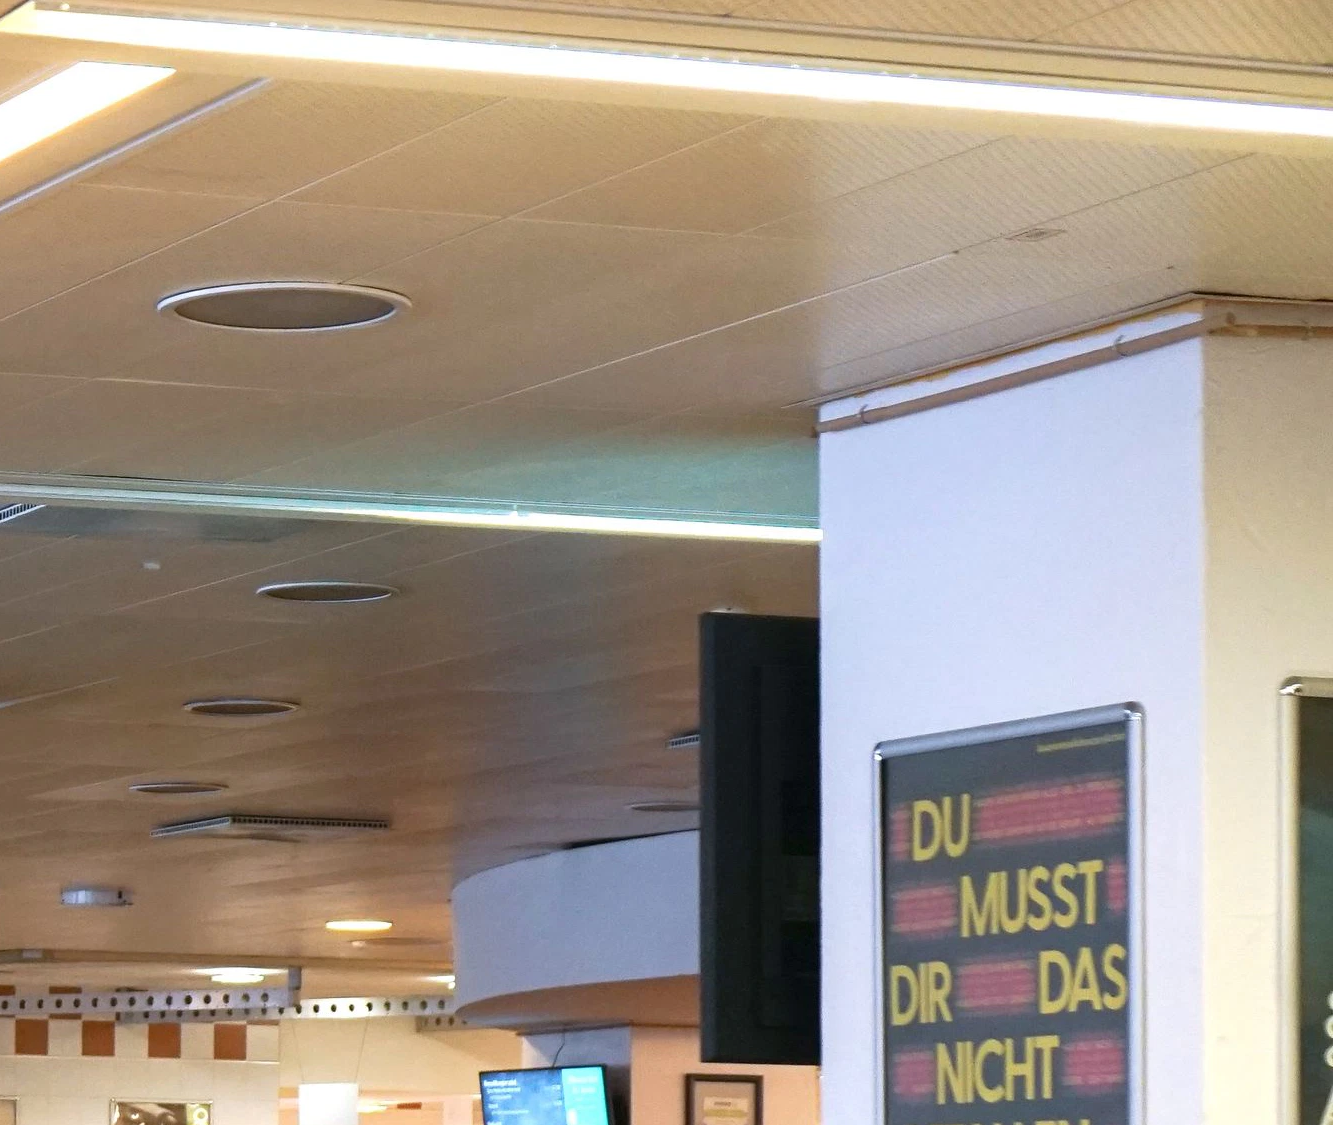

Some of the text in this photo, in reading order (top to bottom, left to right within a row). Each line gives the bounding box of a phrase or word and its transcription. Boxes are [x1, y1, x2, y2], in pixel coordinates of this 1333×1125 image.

[911, 793, 972, 861] DU
[959, 860, 1104, 938] MUSST
[890, 943, 1127, 1026] DIR DAS
[935, 1034, 1060, 1105] NICHT
